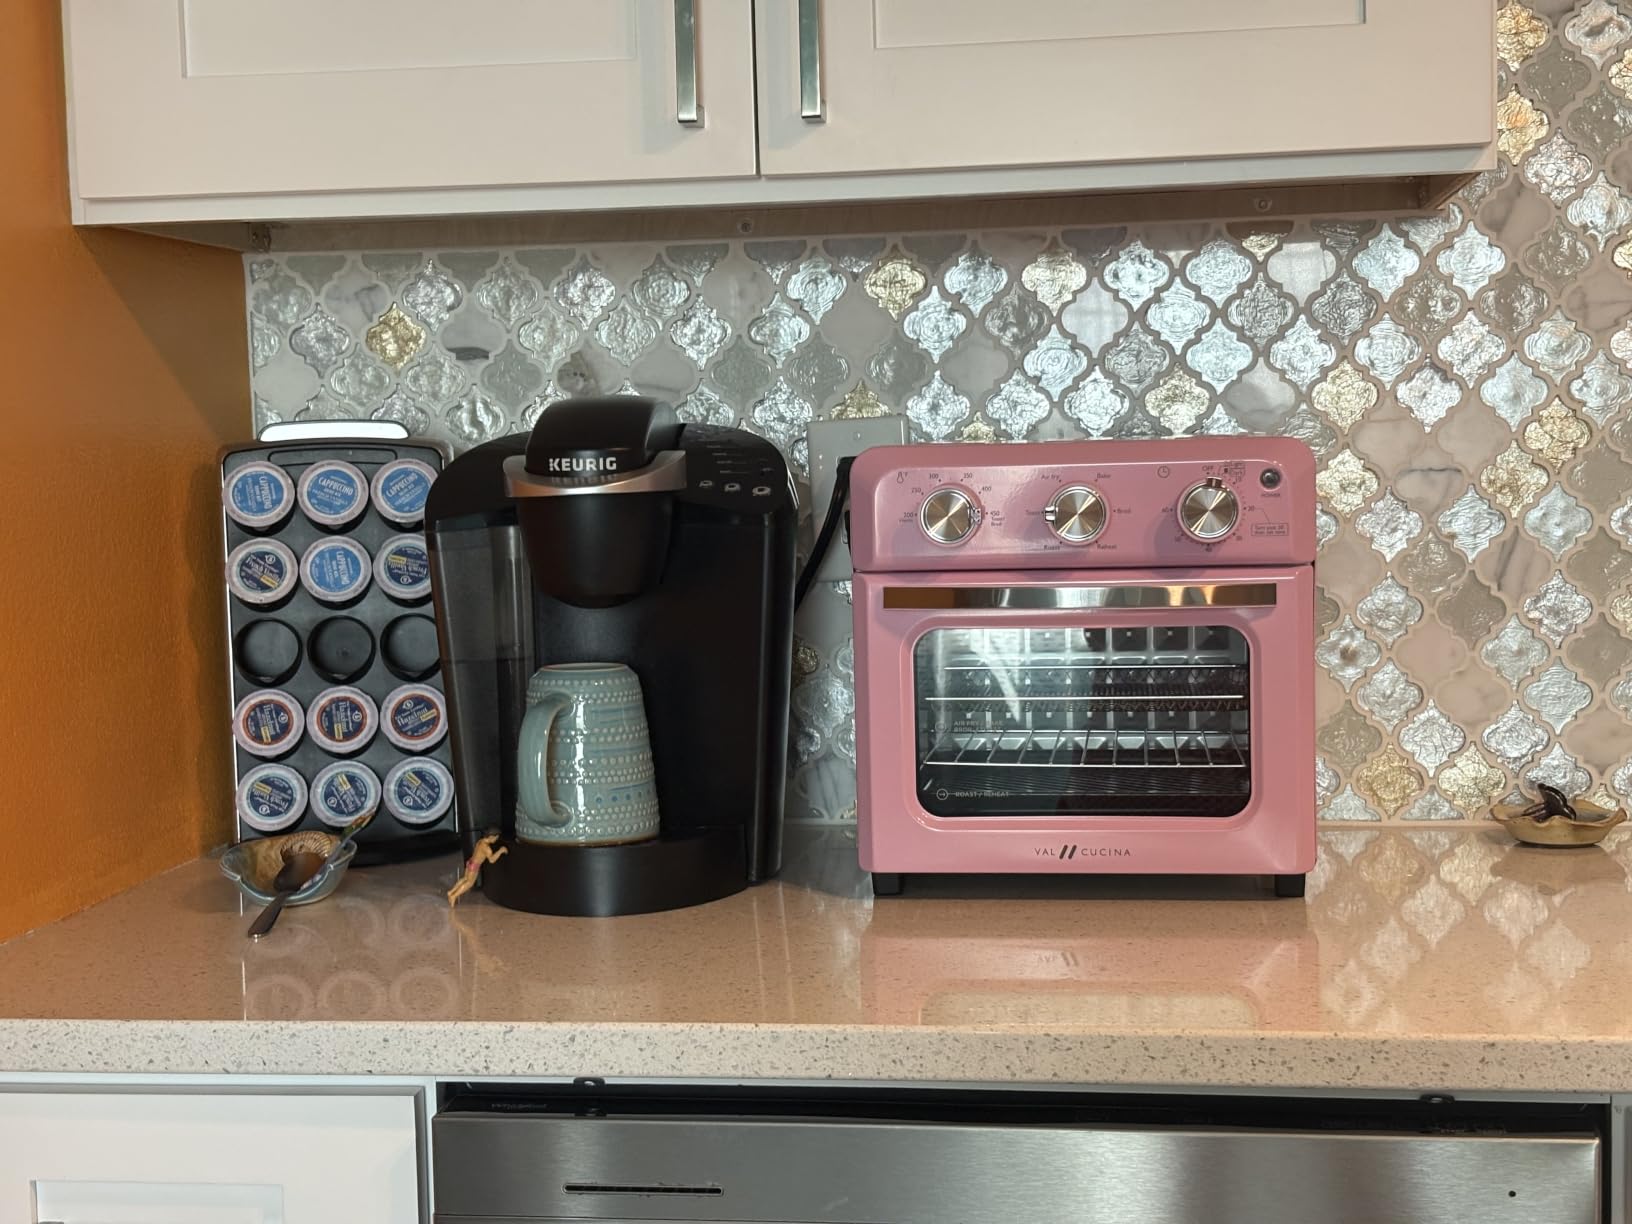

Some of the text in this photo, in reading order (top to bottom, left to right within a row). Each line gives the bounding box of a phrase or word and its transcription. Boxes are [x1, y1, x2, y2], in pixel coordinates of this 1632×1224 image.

[548, 457, 617, 472] KEURIG
[318, 476, 354, 496] CAPPUCCINO
[1034, 847, 1132, 857] VAL CUCINA
